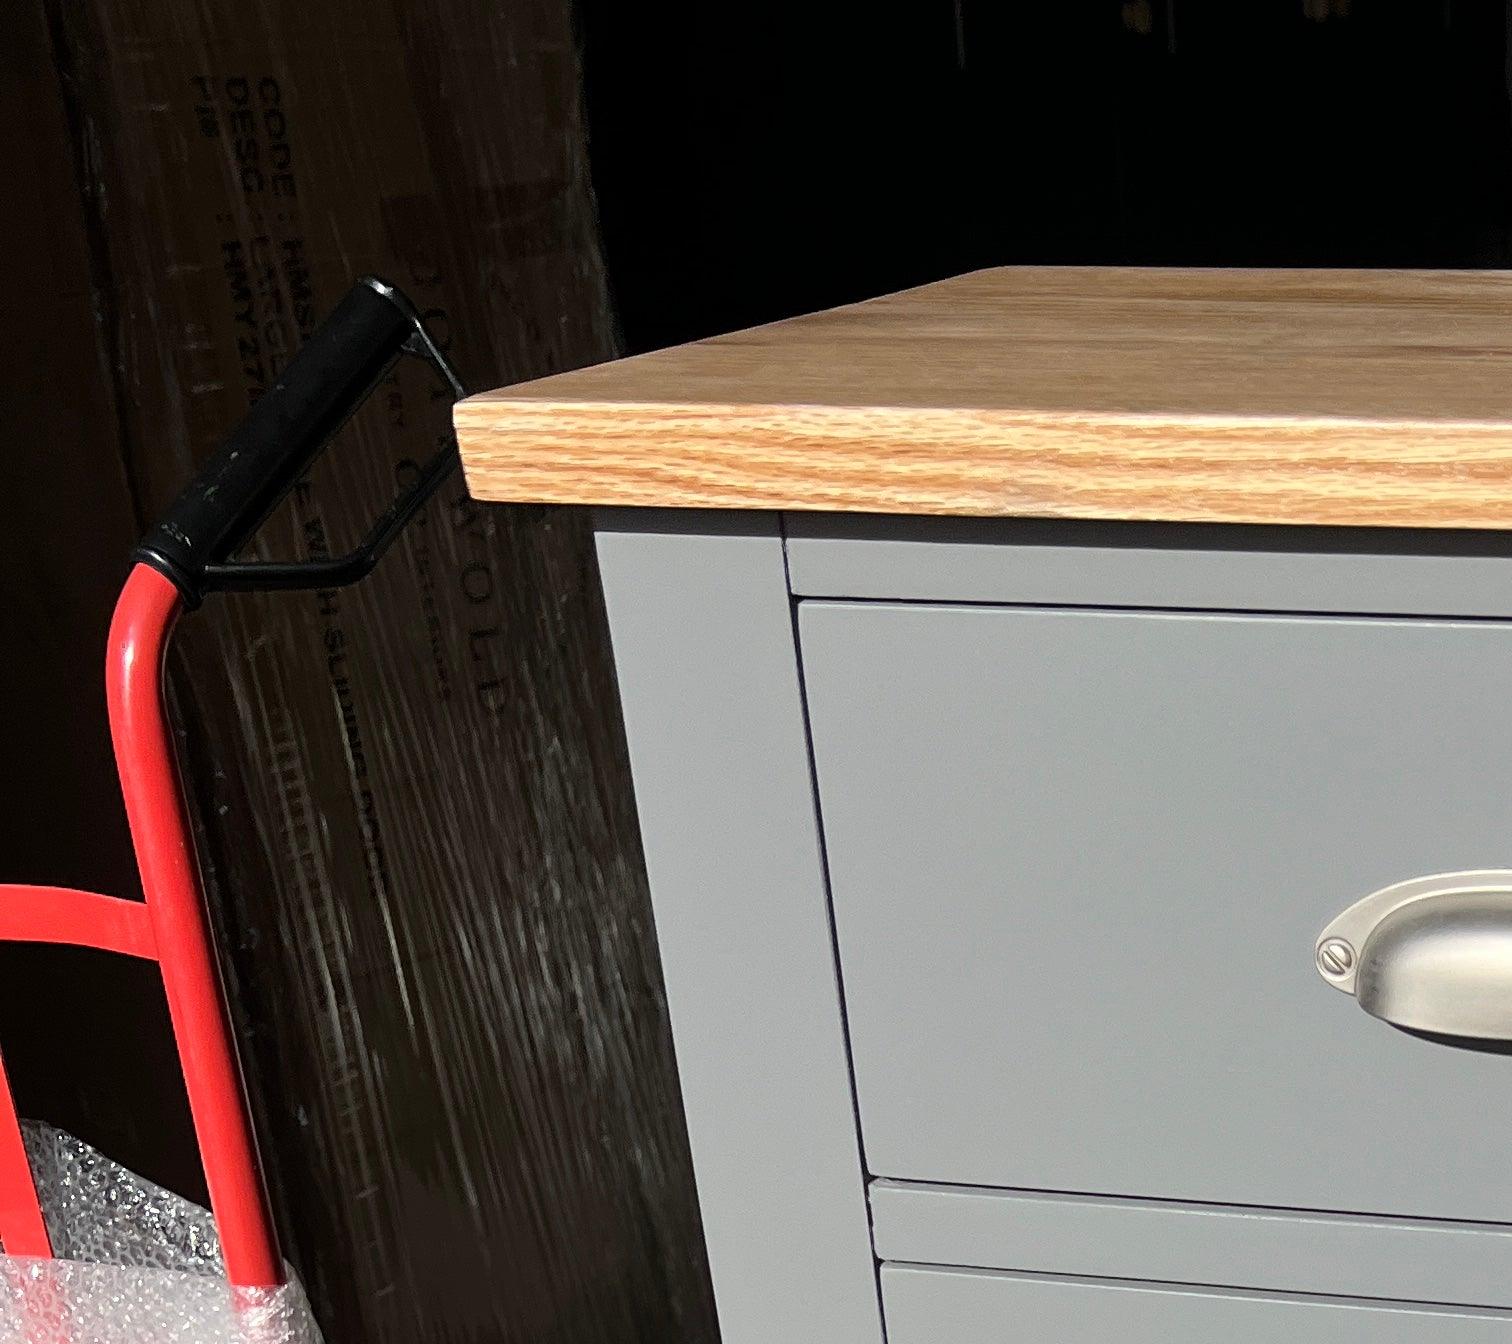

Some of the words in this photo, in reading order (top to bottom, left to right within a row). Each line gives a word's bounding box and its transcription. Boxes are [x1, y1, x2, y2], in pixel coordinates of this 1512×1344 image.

[225, 77, 267, 194] DESC
[257, 75, 297, 199] CODE
[303, 515, 339, 616] WIH
